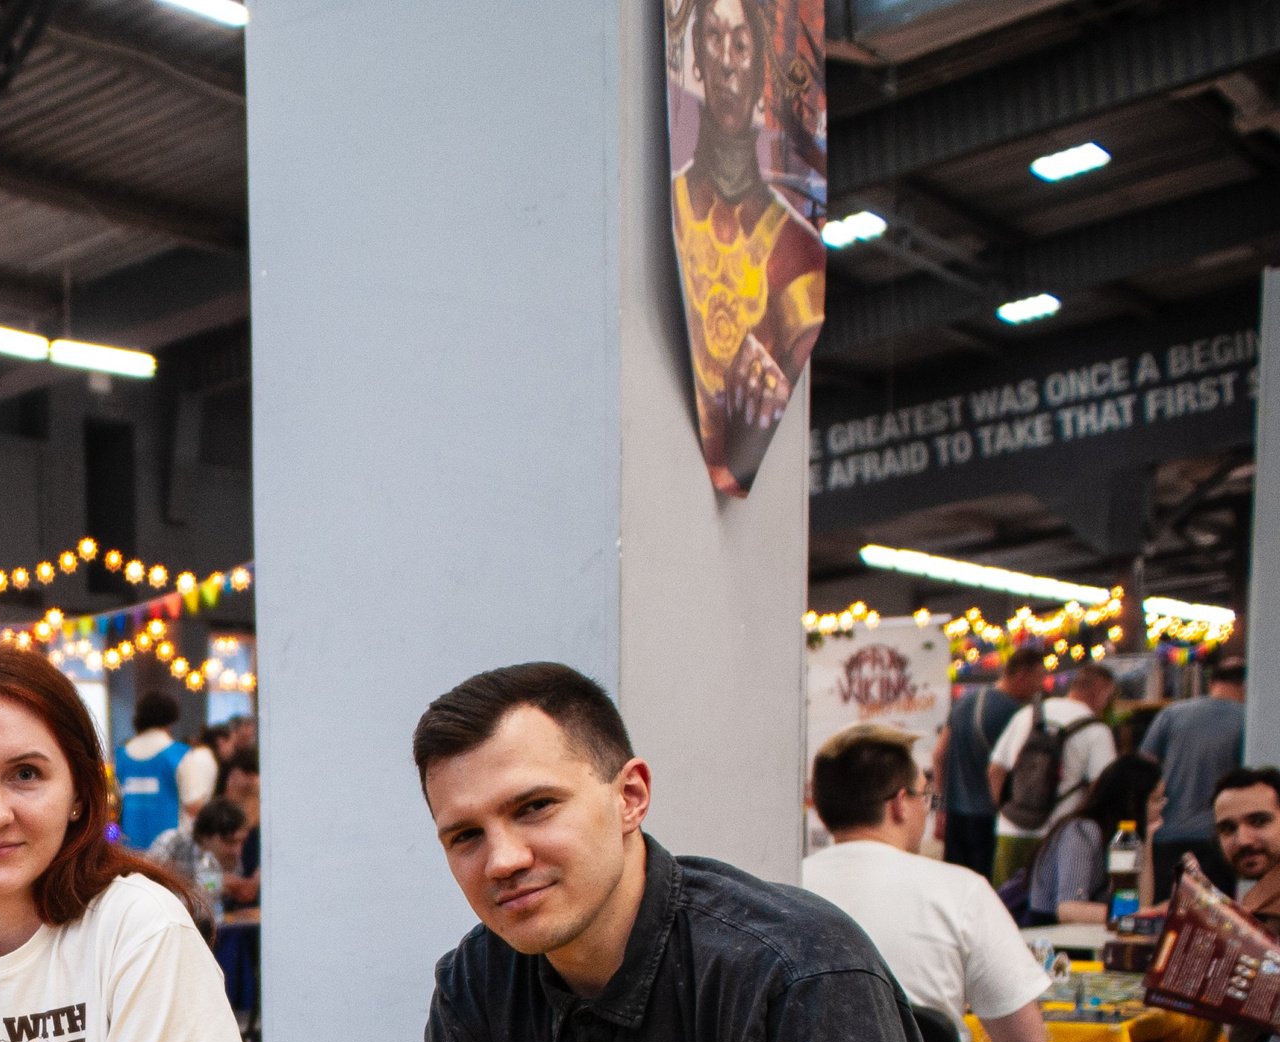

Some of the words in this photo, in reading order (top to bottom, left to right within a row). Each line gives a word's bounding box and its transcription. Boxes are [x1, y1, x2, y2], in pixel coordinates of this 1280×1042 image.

[827, 398, 963, 455] GREATEST
[971, 377, 1039, 422] WAS
[1045, 356, 1129, 407] ONCE
[1136, 352, 1161, 387] A
[1167, 329, 1259, 378] BEGIN
[828, 440, 930, 492] AFRAID
[934, 430, 973, 468] TO
[977, 412, 1054, 458] TAKE
[1057, 394, 1138, 440] THAT
[1143, 371, 1240, 424] FIRST
[1246, 366, 1260, 399] S
